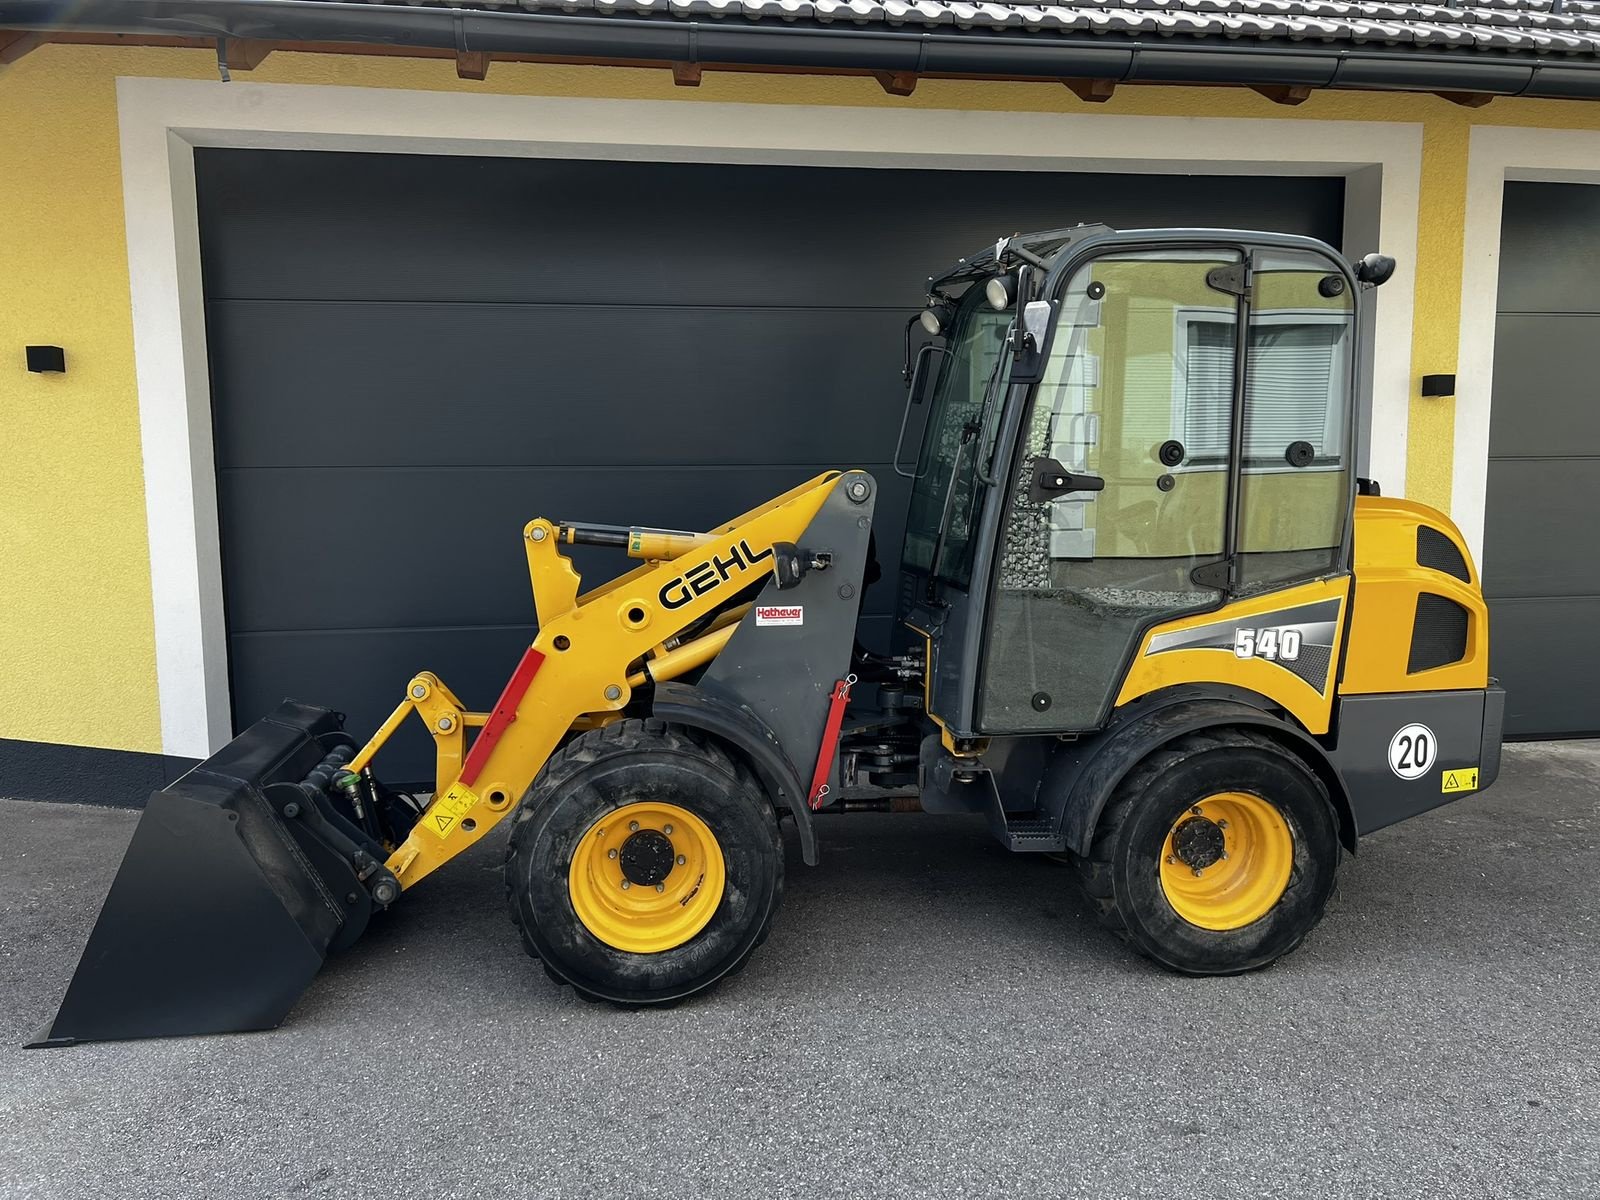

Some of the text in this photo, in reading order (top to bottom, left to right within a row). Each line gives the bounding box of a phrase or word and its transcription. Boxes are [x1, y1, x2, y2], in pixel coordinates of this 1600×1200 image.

[658, 539, 773, 610] GEHL
[1234, 628, 1302, 660] 540
[1398, 734, 1428, 769] 20
